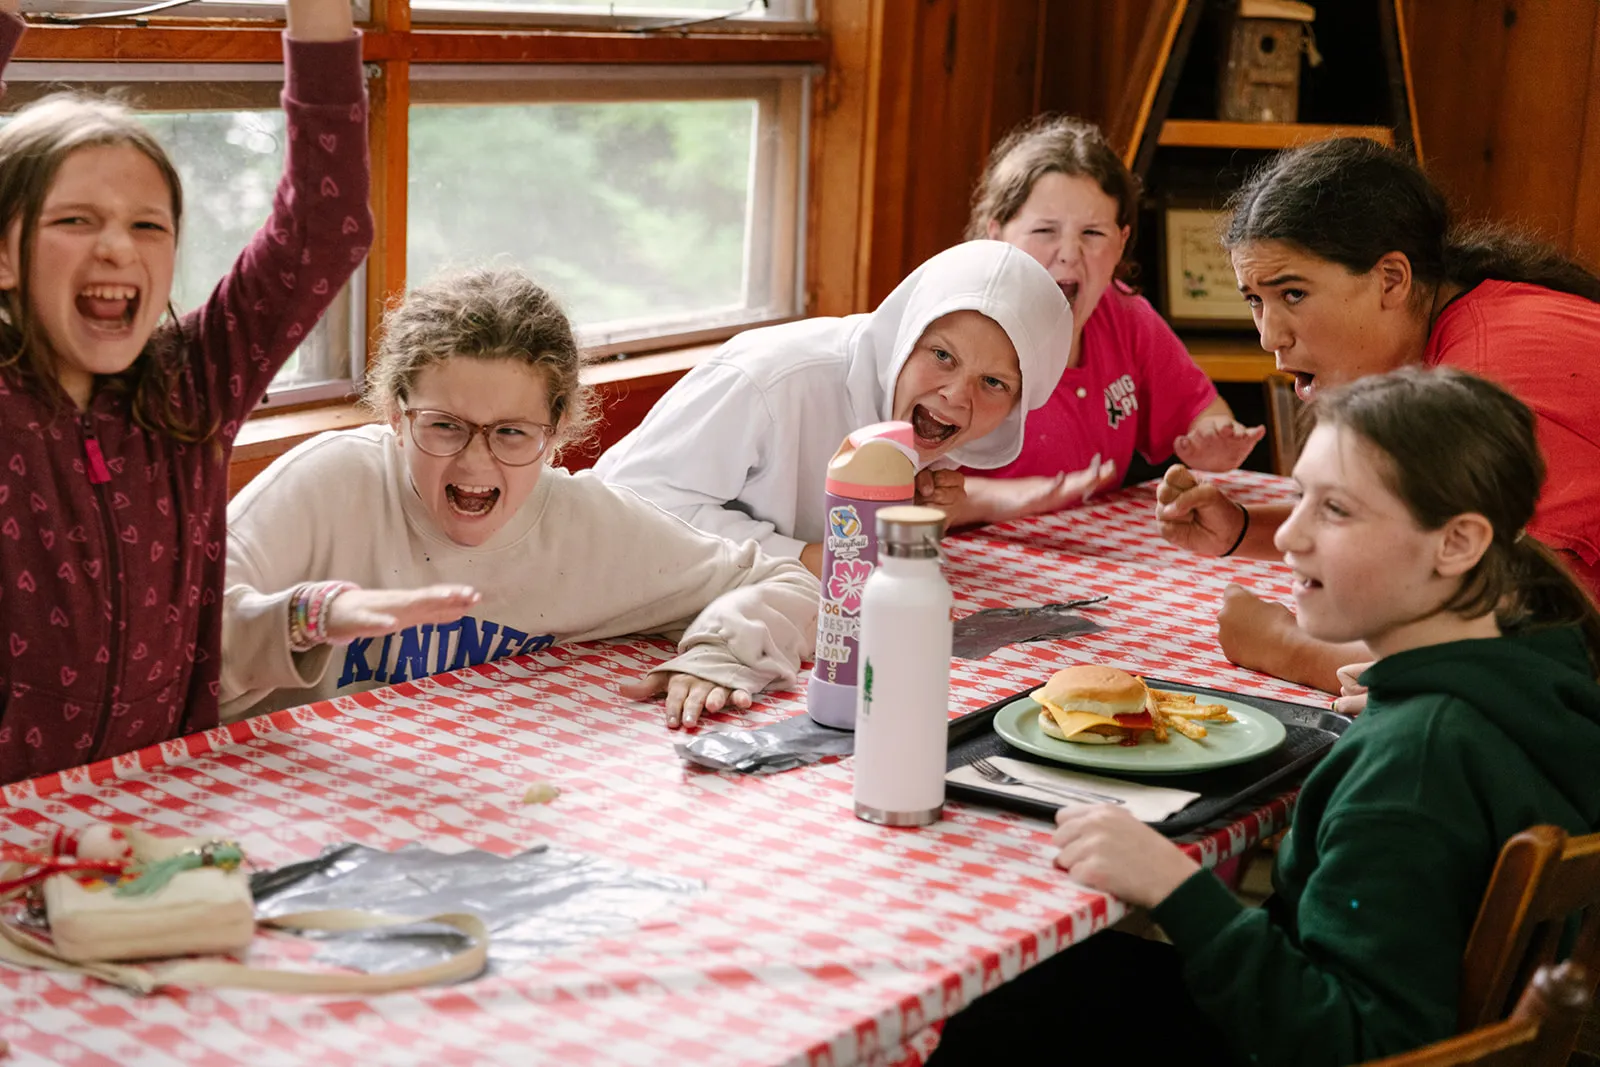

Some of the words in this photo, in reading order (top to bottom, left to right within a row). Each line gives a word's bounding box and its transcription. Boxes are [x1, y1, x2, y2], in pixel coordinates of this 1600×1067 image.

[829, 536, 868, 551] Volleyball
[821, 602, 840, 616] OG
[823, 616, 853, 632] BEST
[826, 632, 842, 645] OF
[823, 646, 849, 661] DAY
